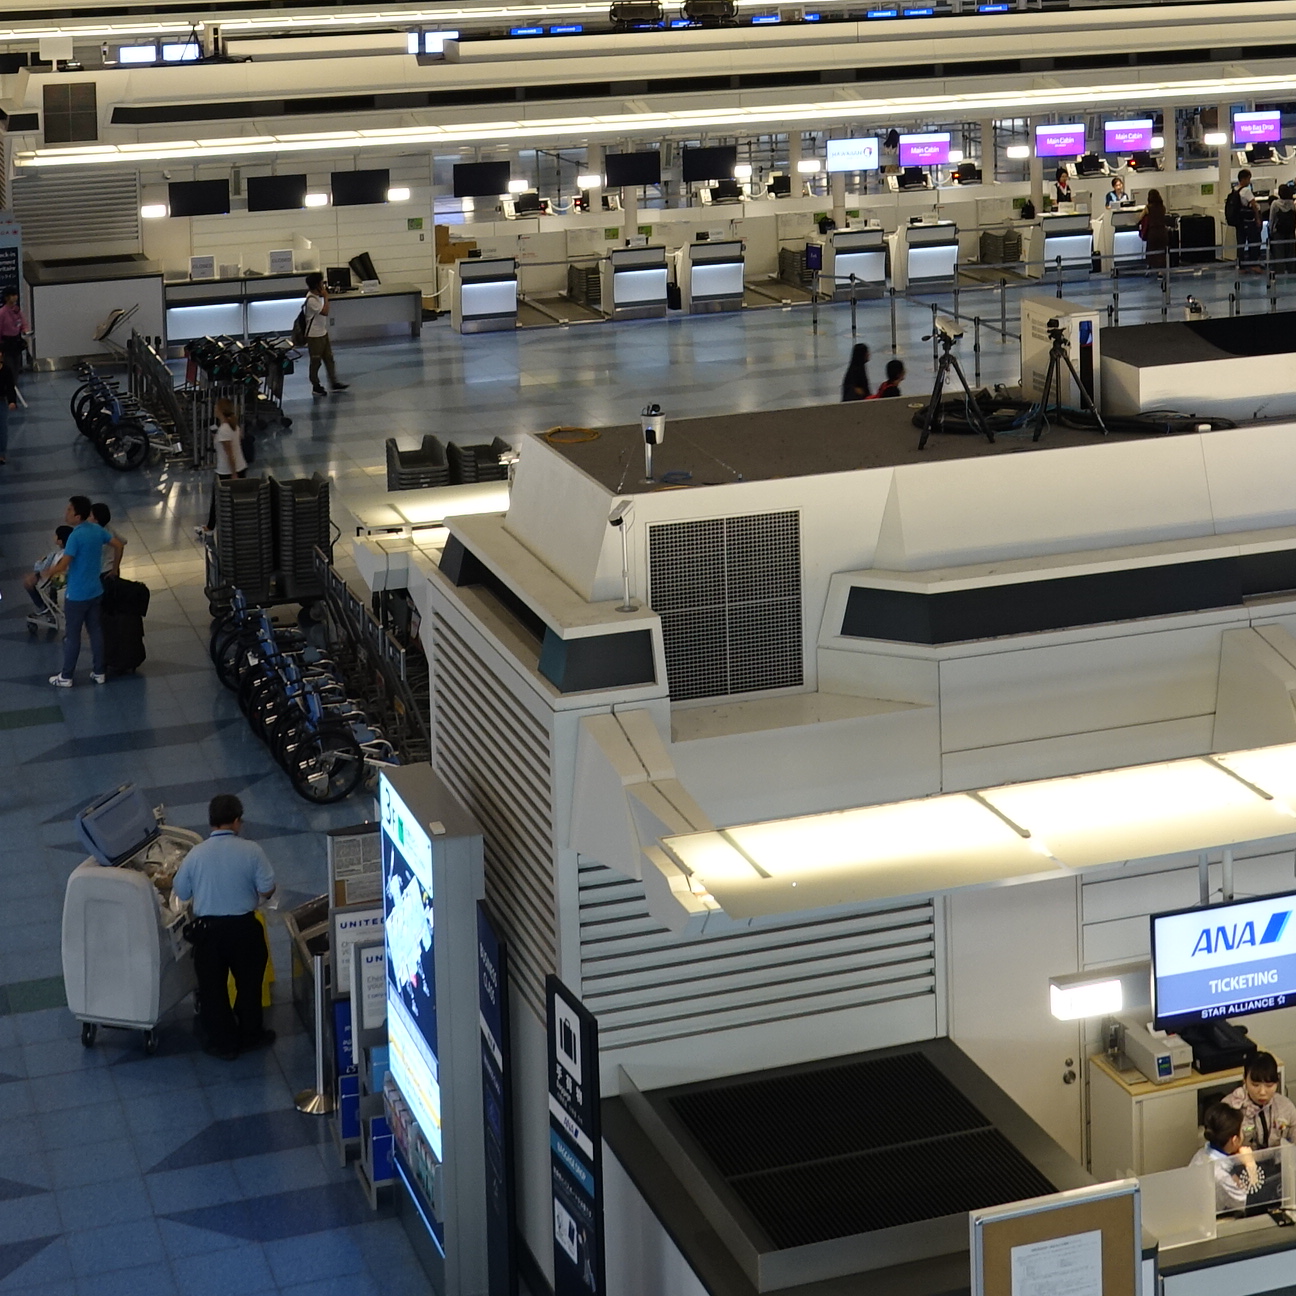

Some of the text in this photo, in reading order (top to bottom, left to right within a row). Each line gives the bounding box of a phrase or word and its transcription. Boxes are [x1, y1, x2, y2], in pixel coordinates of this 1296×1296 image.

[1262, 123, 1275, 131] Drop
[1046, 135, 1075, 145] Main Cabin
[1115, 131, 1143, 140] Main Cabin
[910, 145, 940, 154] Main Cabin
[1191, 921, 1257, 958] ANA
[1209, 969, 1279, 994] TICKETING
[1201, 997, 1275, 1019] STAR ALLIANCE
